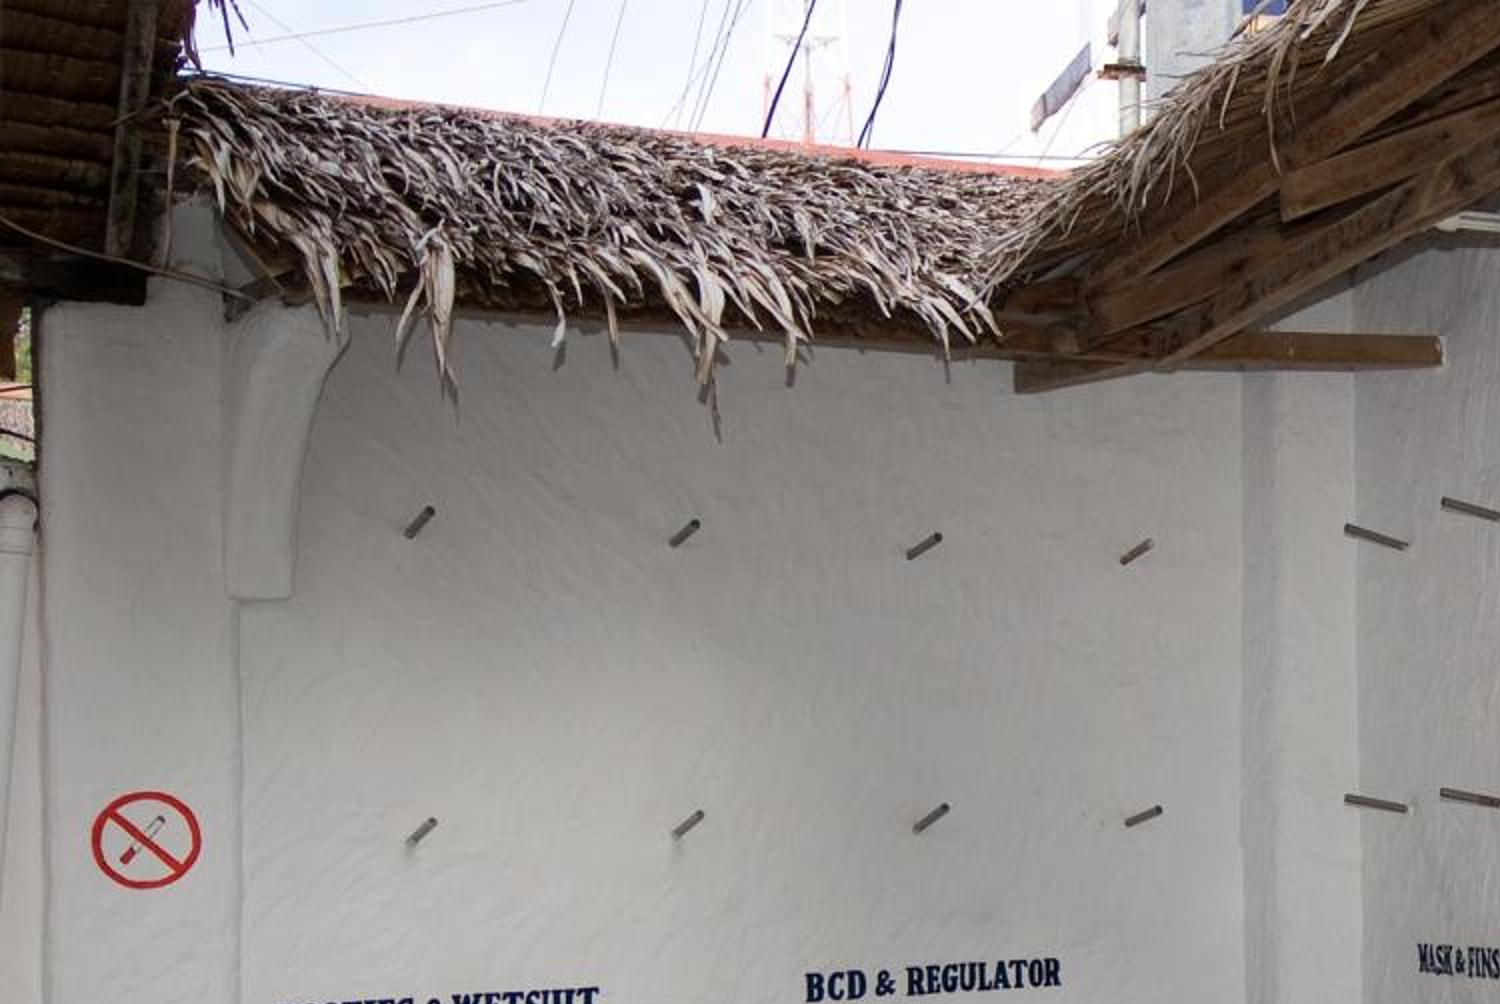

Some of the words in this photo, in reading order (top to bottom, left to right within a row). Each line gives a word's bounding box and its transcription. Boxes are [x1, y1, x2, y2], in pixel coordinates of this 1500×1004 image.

[805, 970, 867, 1003] BCD
[875, 970, 897, 997] &
[905, 957, 1062, 997] REGULATOR
[1456, 946, 1465, 973] &
[1468, 947, 1500, 980] FINS
